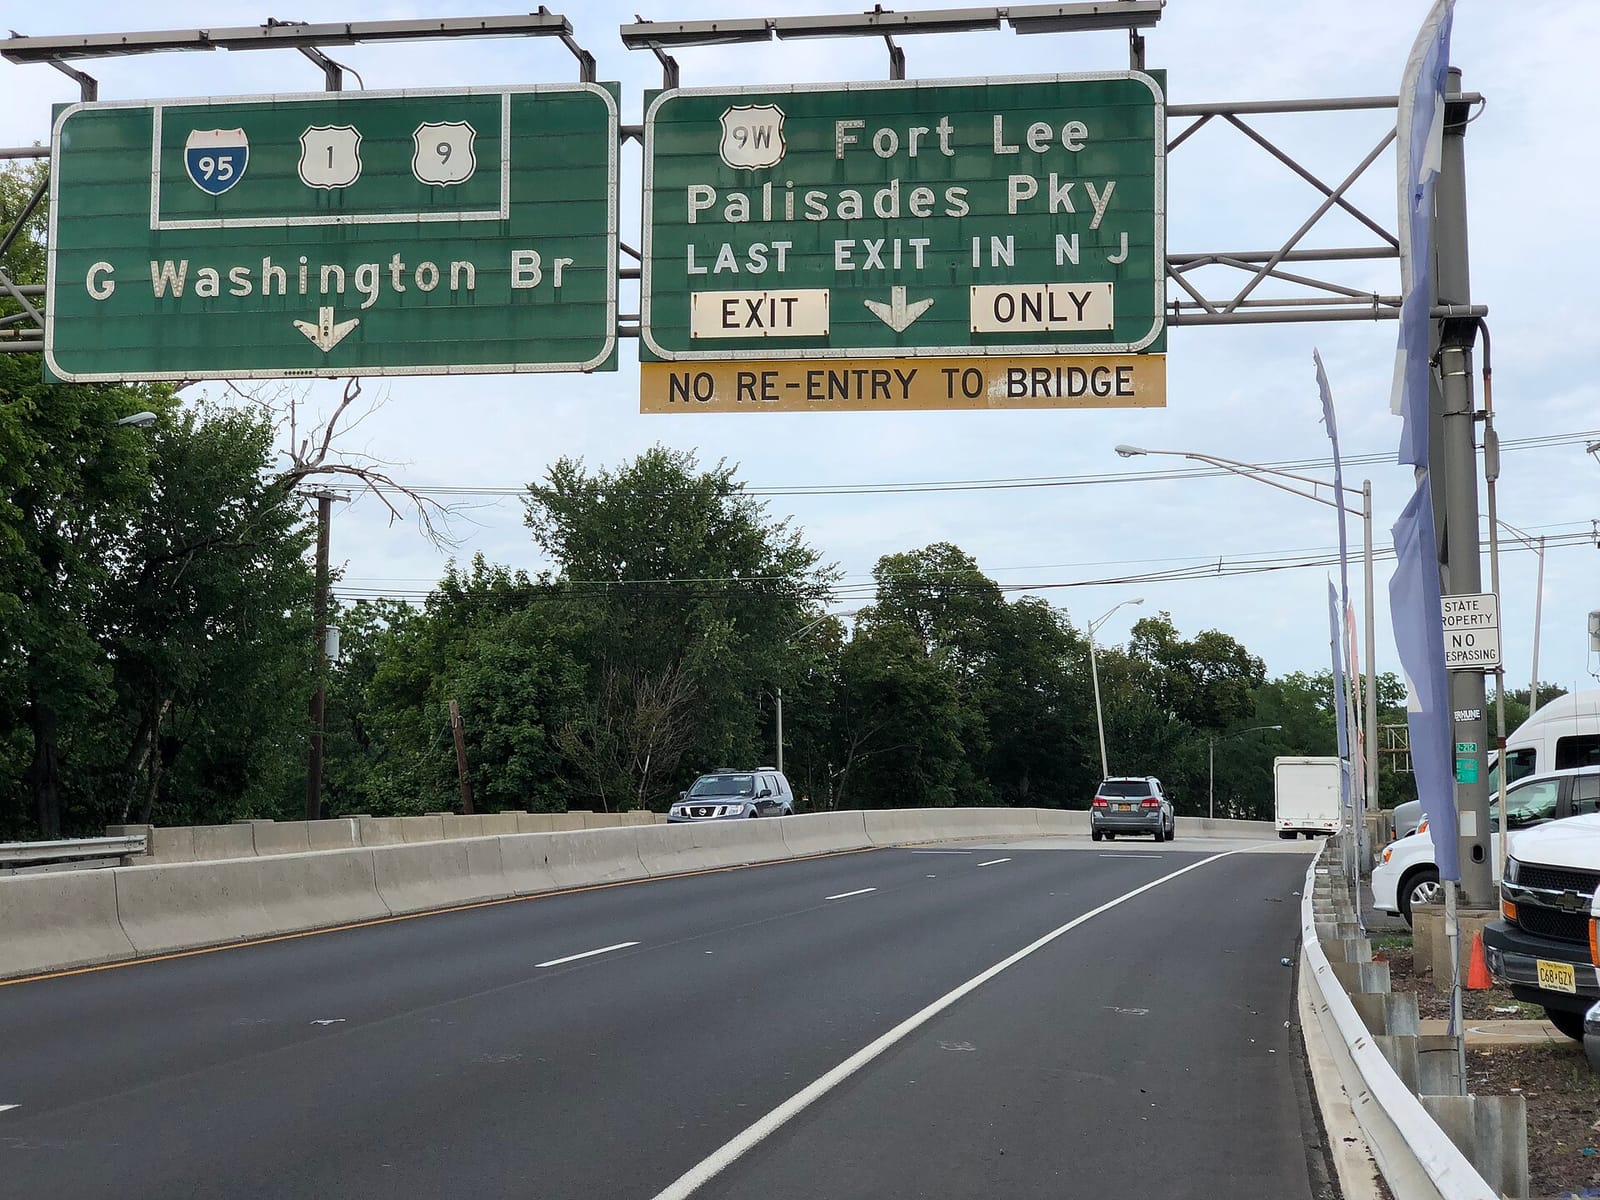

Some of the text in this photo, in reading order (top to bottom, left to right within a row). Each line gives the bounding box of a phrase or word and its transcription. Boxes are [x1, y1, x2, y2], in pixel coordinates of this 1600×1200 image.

[733, 115, 1089, 160] 9W Fort Lee
[326, 145, 333, 169] 1
[436, 141, 452, 165] 9
[199, 156, 234, 181] 95
[687, 173, 1116, 230] Palisades Pky
[687, 232, 1129, 275] LAST EXIT IN N J
[86, 250, 574, 309] G Washington Br
[722, 298, 799, 328] EXIT
[993, 292, 1092, 323] ONLY
[669, 366, 1135, 402] NO RE-ENTRY TO BRIDGE
[1444, 600, 1480, 612] STATE
[1442, 614, 1492, 626] ROPERTY
[1452, 634, 1475, 648] NO
[1446, 649, 1496, 662] ESPASSING
